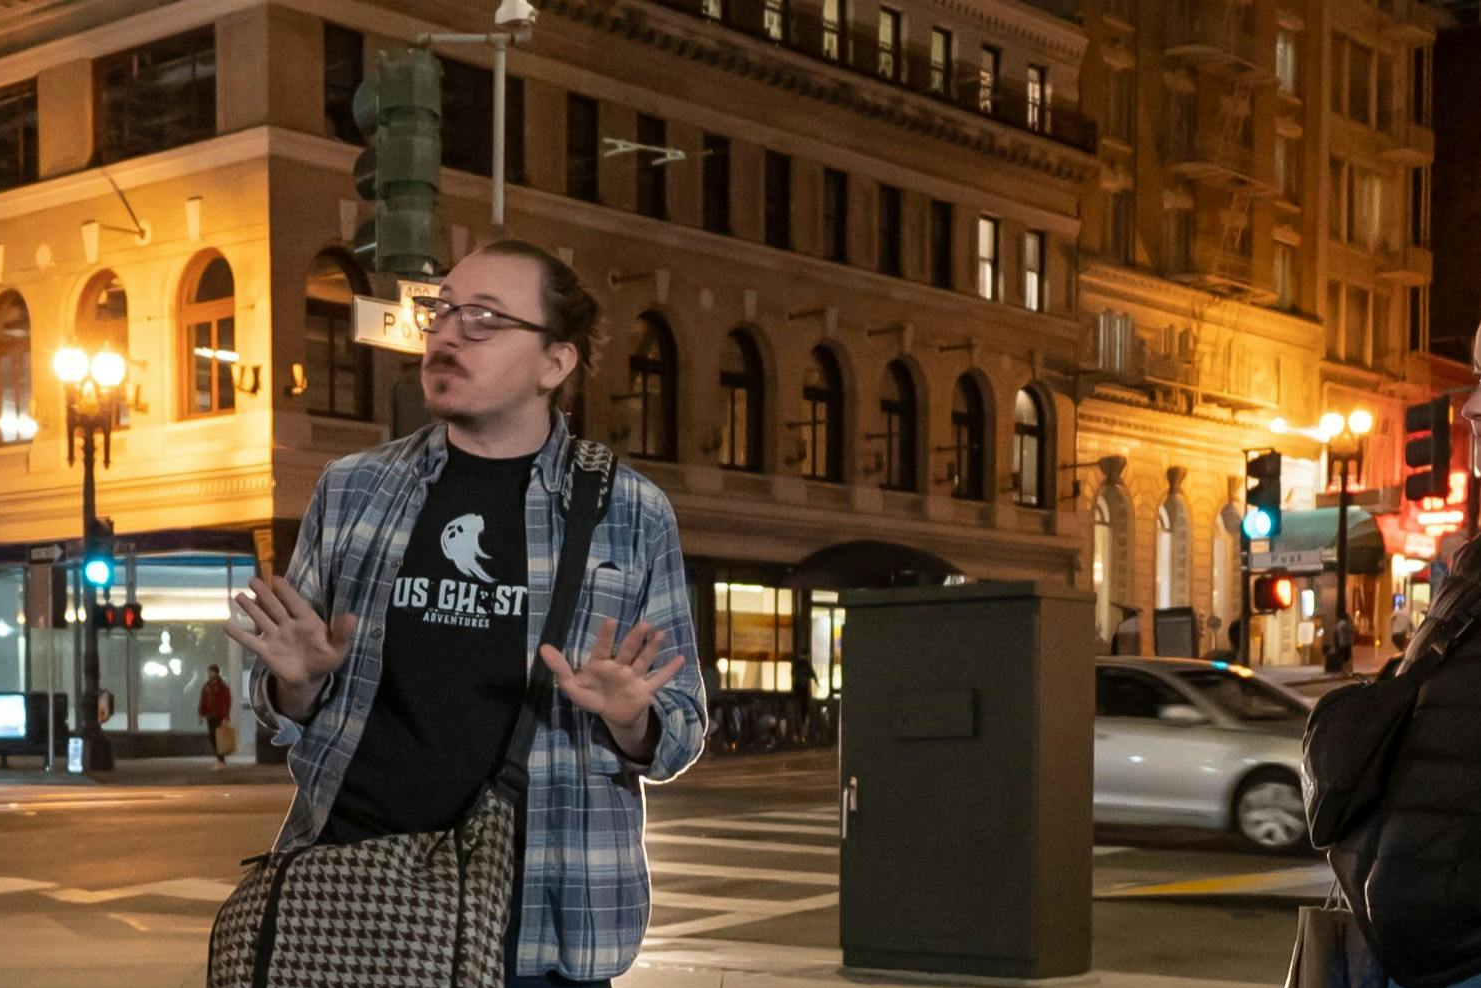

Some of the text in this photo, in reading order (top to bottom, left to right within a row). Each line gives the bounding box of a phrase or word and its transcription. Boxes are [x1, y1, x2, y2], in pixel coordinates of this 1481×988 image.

[383, 311, 424, 341] Po
[393, 577, 429, 608] US
[422, 611, 490, 629] ADVENTURES
